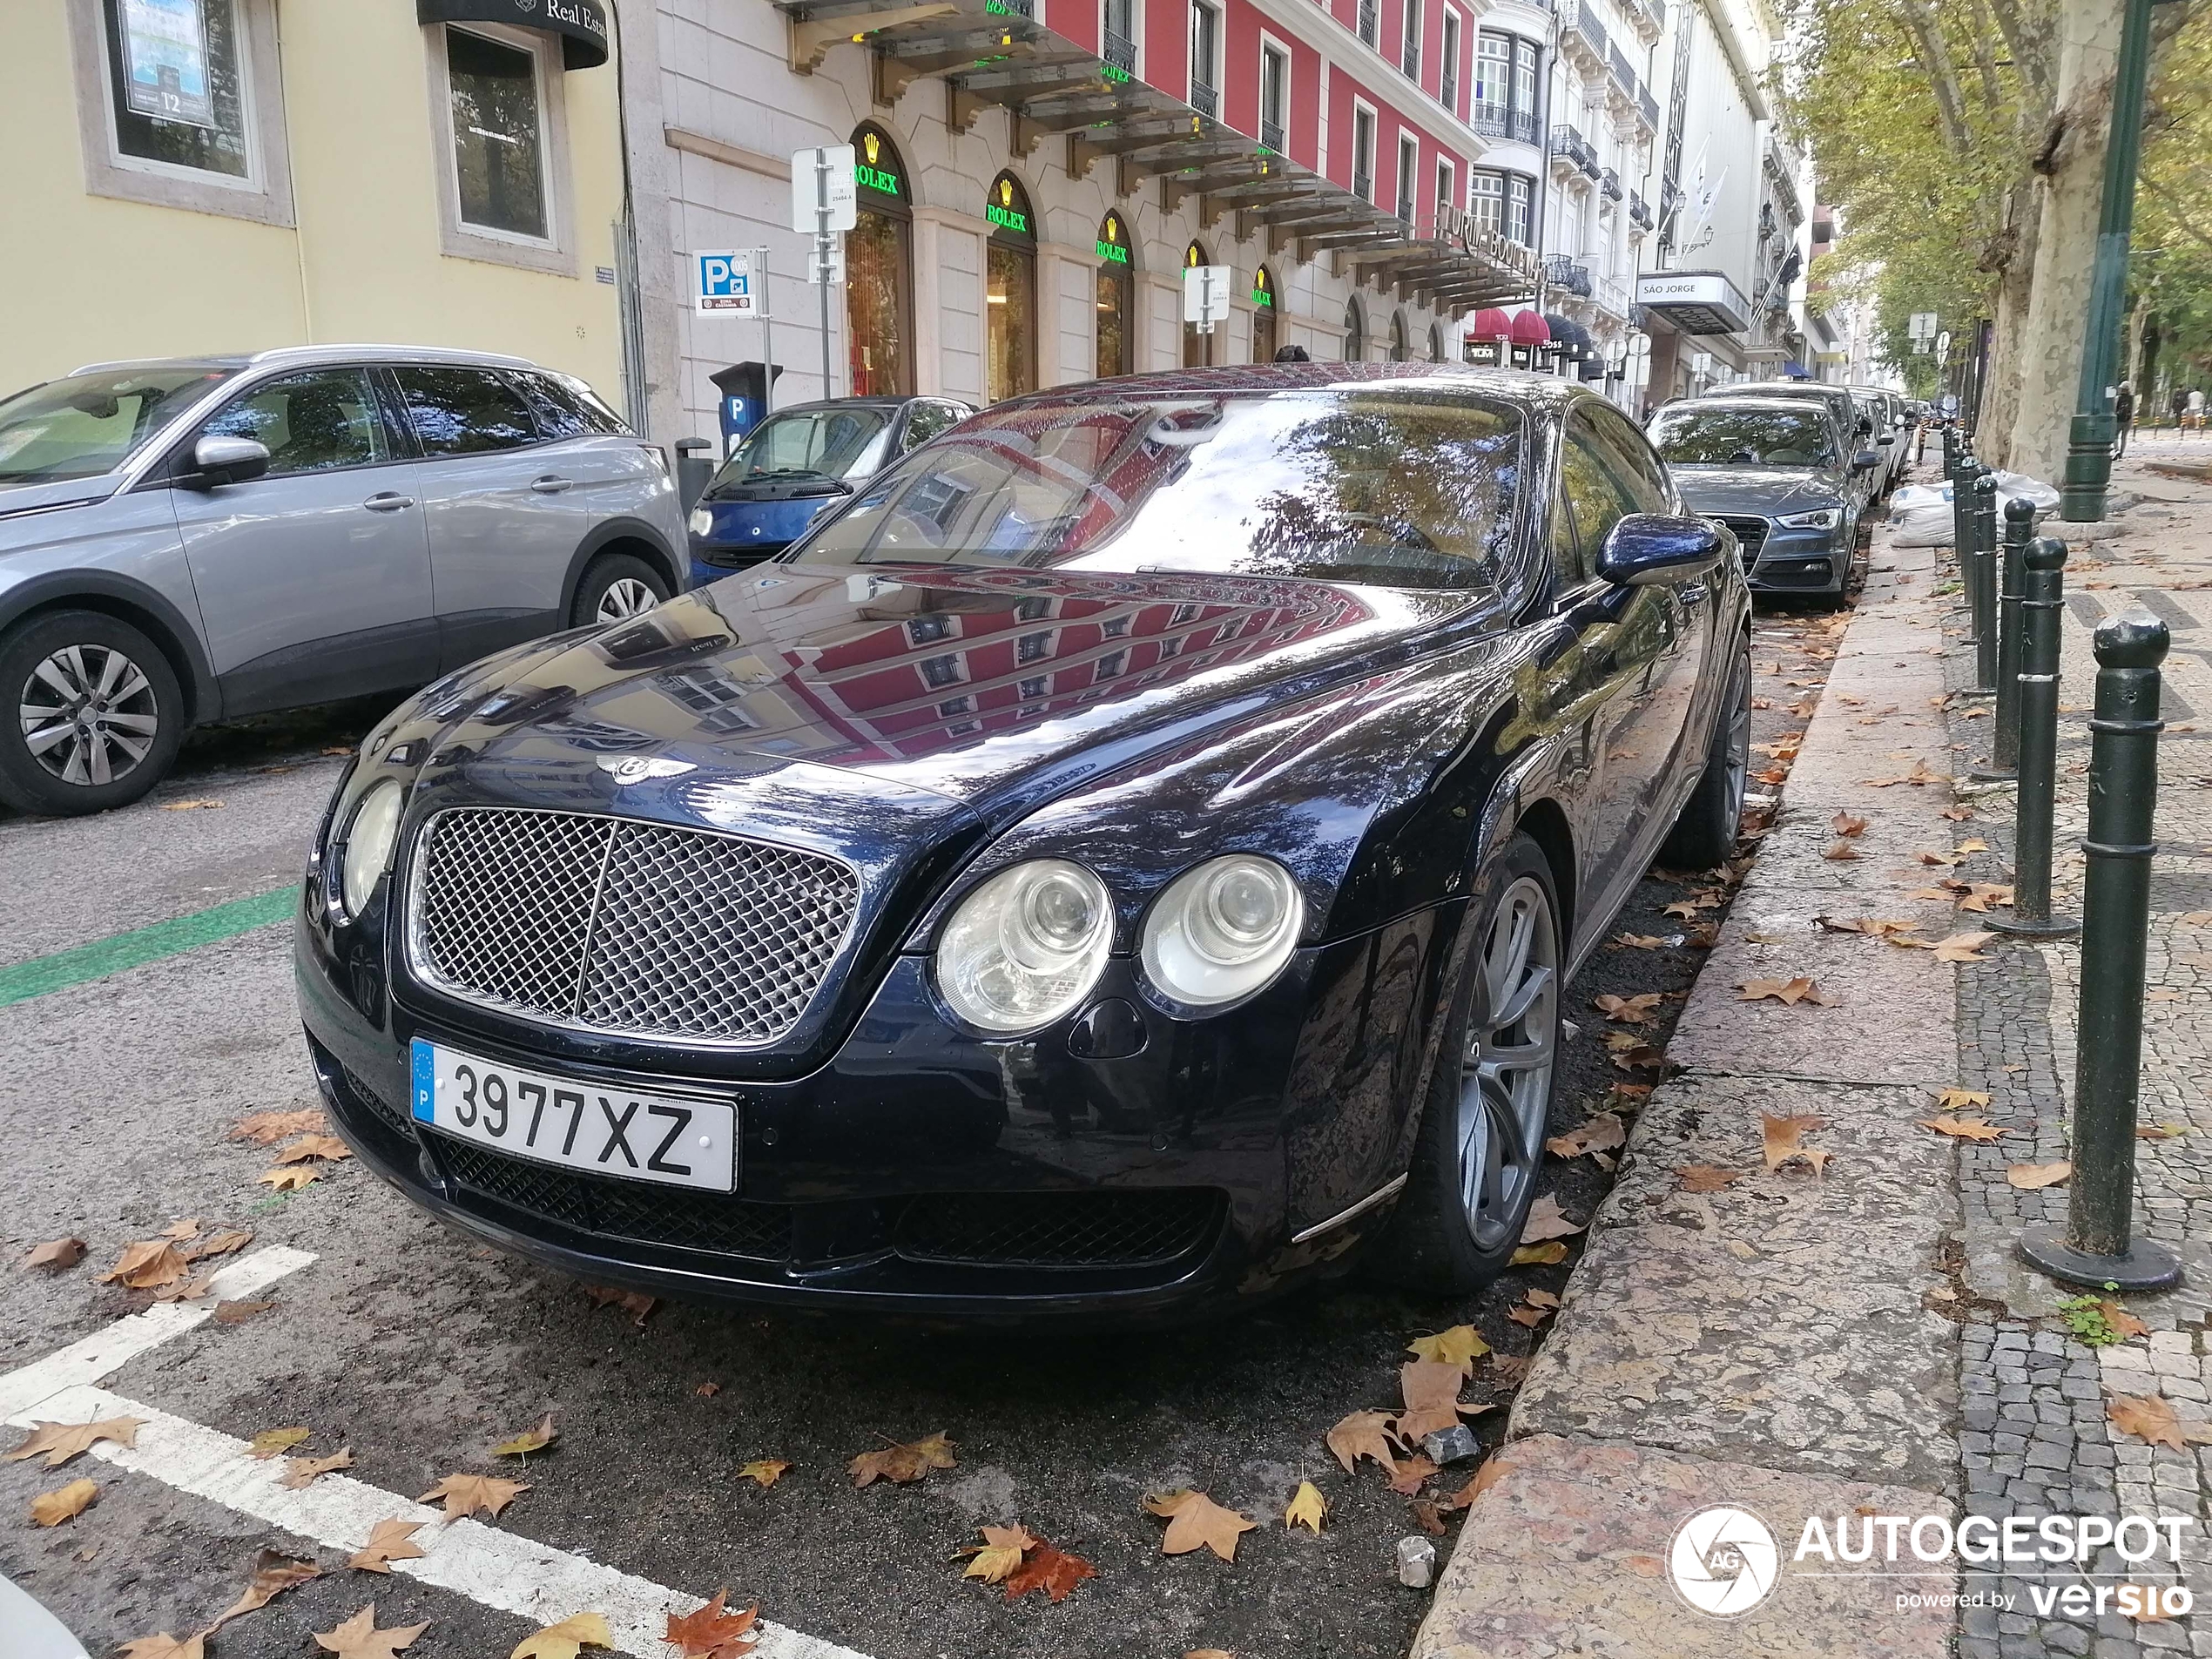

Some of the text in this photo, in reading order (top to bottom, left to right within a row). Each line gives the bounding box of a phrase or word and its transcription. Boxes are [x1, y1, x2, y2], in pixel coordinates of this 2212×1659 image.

[547, 0, 581, 24] Real
[161, 91, 181, 113] T2
[987, 204, 1026, 232] ROLEX
[1096, 240, 1127, 263] ROLEX
[705, 259, 730, 294] P
[1665, 284, 1696, 293] JORGE
[732, 398, 744, 420] P
[420, 1089, 428, 1106] P
